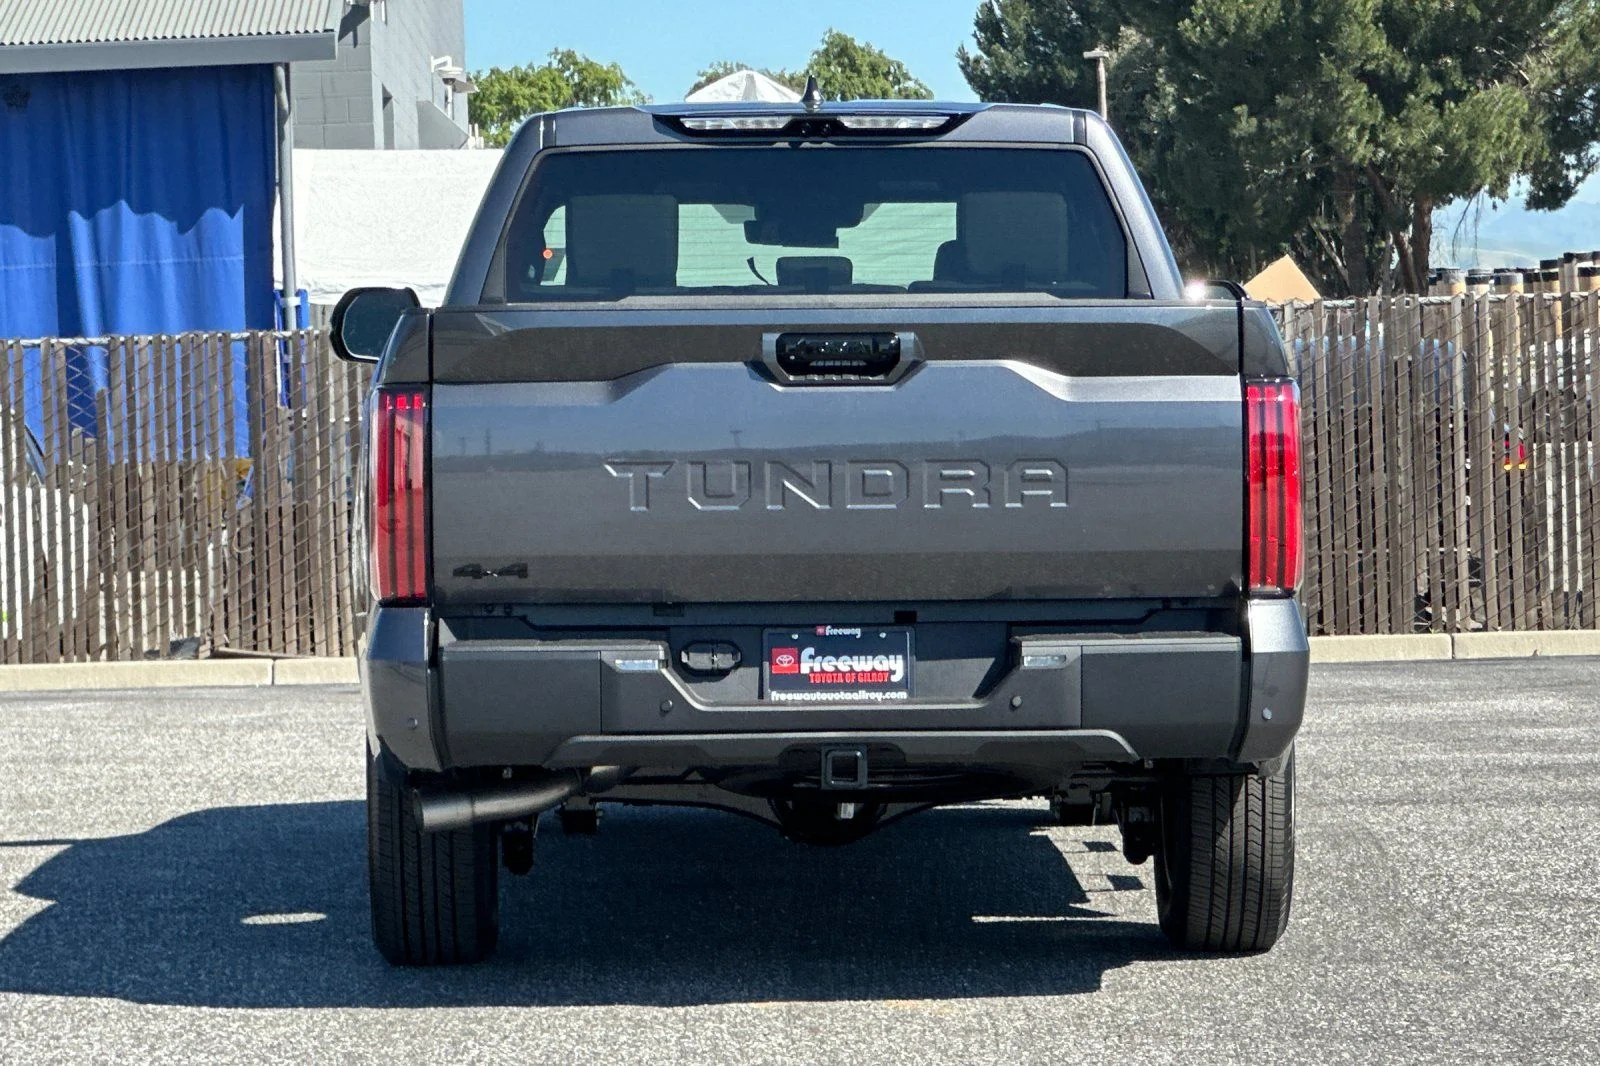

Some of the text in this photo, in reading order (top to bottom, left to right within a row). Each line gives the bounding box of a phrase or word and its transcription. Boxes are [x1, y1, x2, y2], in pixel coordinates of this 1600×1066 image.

[604, 458, 1069, 512] TUNDRA
[800, 647, 904, 682] freeway
[809, 672, 889, 684] TOYOTA OF GILROY
